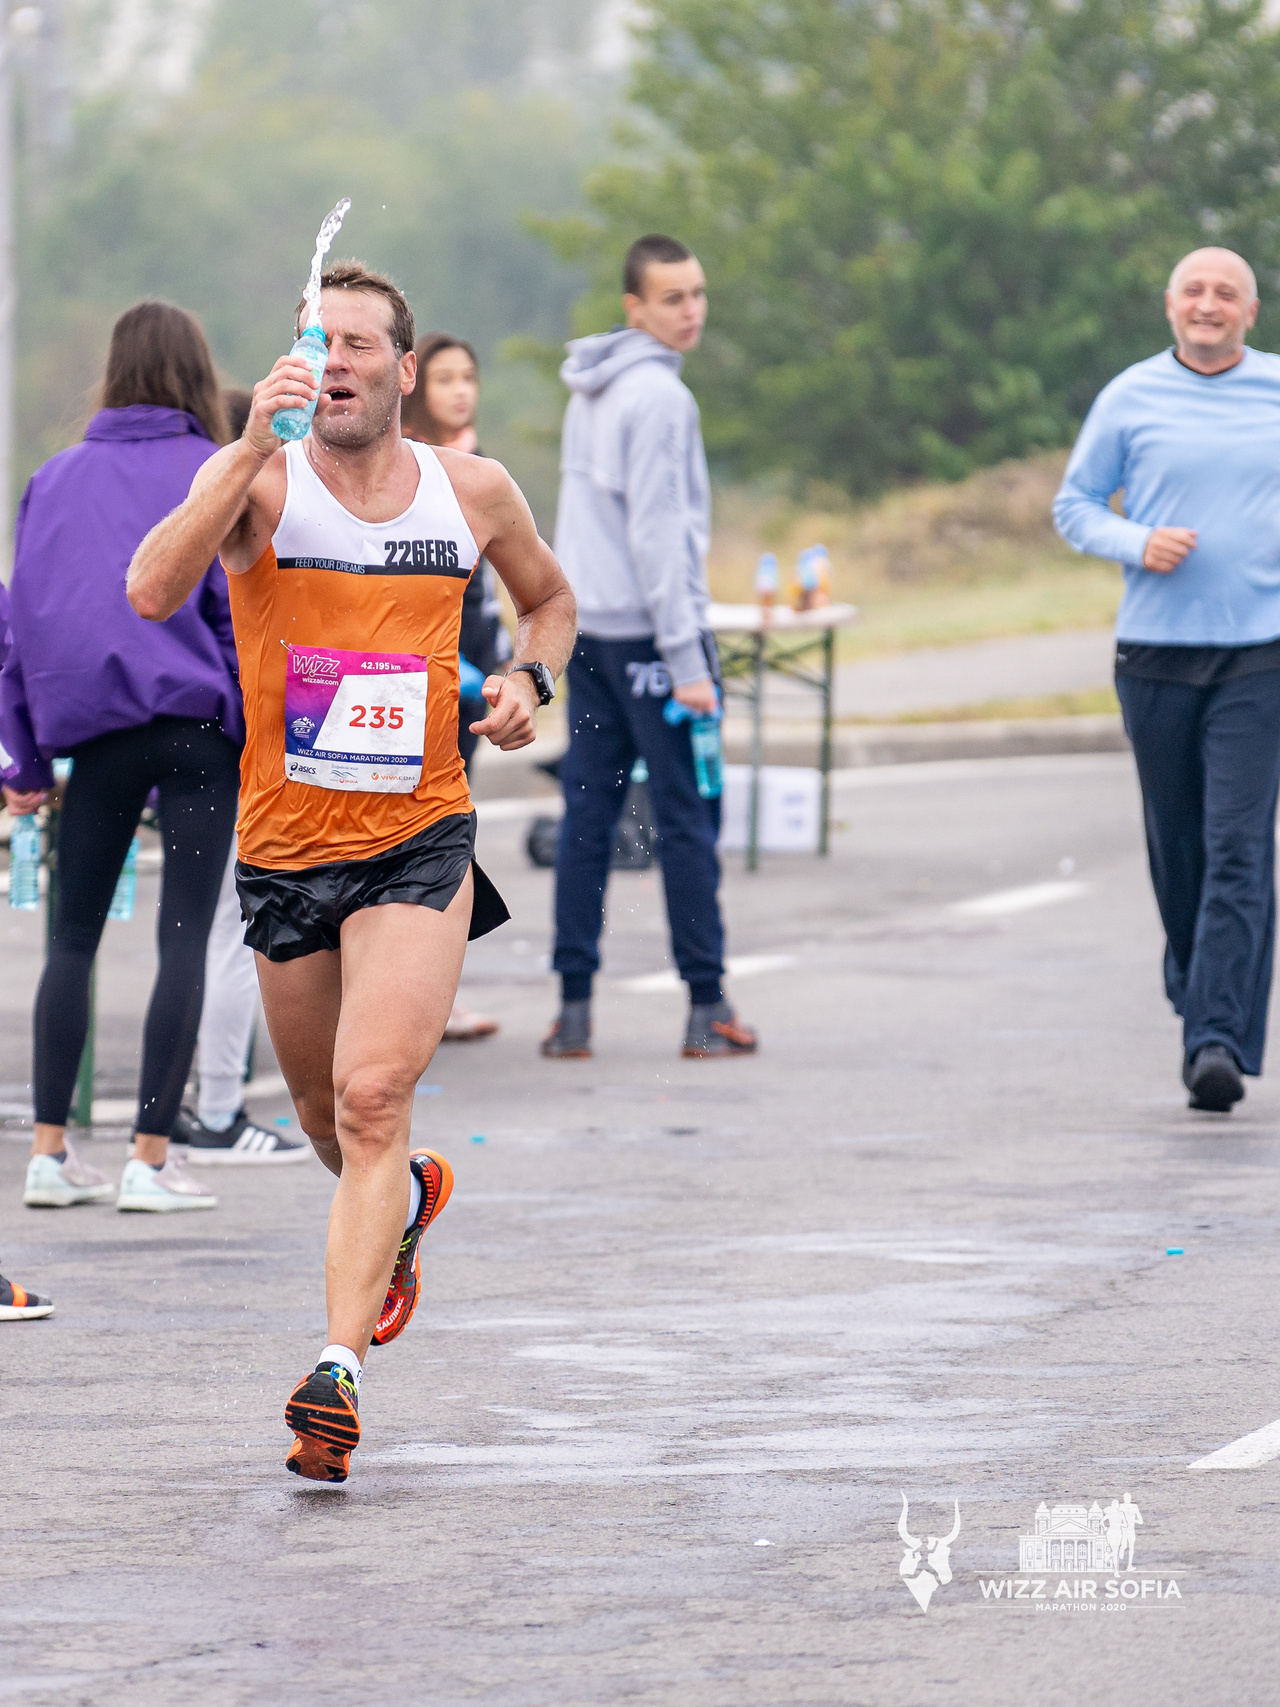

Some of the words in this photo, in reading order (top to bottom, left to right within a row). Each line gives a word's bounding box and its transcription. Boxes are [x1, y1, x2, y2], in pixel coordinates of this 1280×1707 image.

[384, 540, 459, 568] 226ERS
[295, 558, 314, 568] FEED
[315, 559, 335, 570] YOUR
[336, 561, 365, 574] DREAMS
[360, 661, 390, 671] 42.195
[390, 663, 401, 671] km
[302, 677, 339, 686] wizzair.com
[349, 705, 404, 729] 235
[297, 747, 314, 756] WIZZ
[315, 750, 326, 758] AIR
[327, 752, 349, 761] SOFIA
[349, 755, 390, 764] MARATHON
